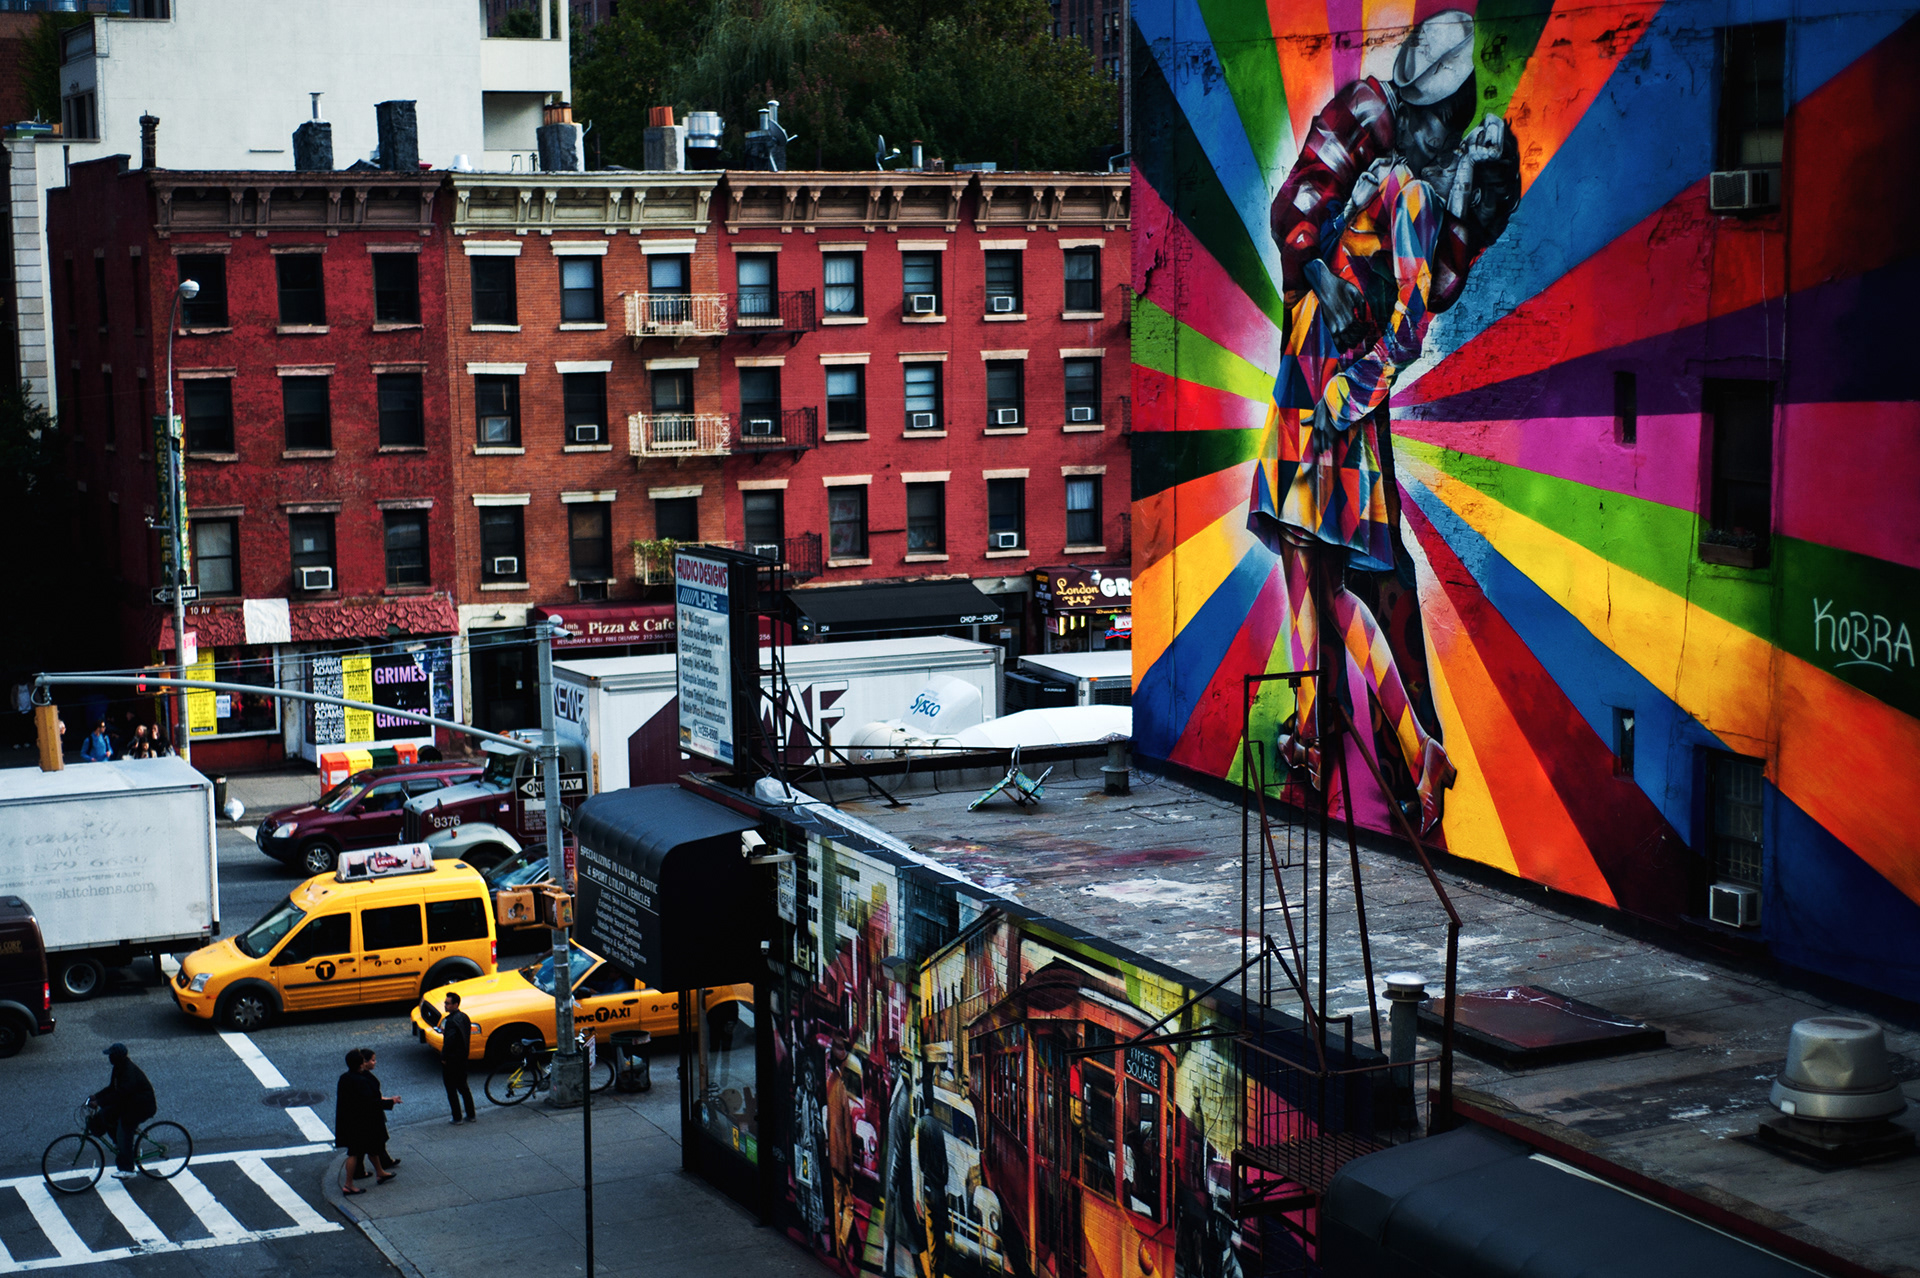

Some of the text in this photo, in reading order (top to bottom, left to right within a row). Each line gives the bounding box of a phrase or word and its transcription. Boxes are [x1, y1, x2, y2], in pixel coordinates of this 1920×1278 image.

[677, 557, 728, 588] AUDIO DESIGNS
[1056, 578, 1099, 595] London
[1100, 578, 1132, 597] GR
[190, 606, 199, 615] 10
[588, 618, 675, 635] Pizza & Cafe
[1813, 598, 1915, 667] KOBRA
[313, 666, 343, 676] ADAMS
[374, 665, 427, 685] GRIMES
[315, 709, 344, 720] ADAMS
[527, 781, 545, 792] ONE
[580, 844, 611, 869] SPECIALIZING
[611, 861, 618, 873] IN
[639, 875, 658, 895] EXOTIC
[591, 867, 607, 884] SPORT
[608, 875, 626, 894] UTILITY
[627, 886, 650, 907] VEHICLES
[1129, 1047, 1156, 1069] TIMES
[1125, 1059, 1159, 1088] SQUARE
